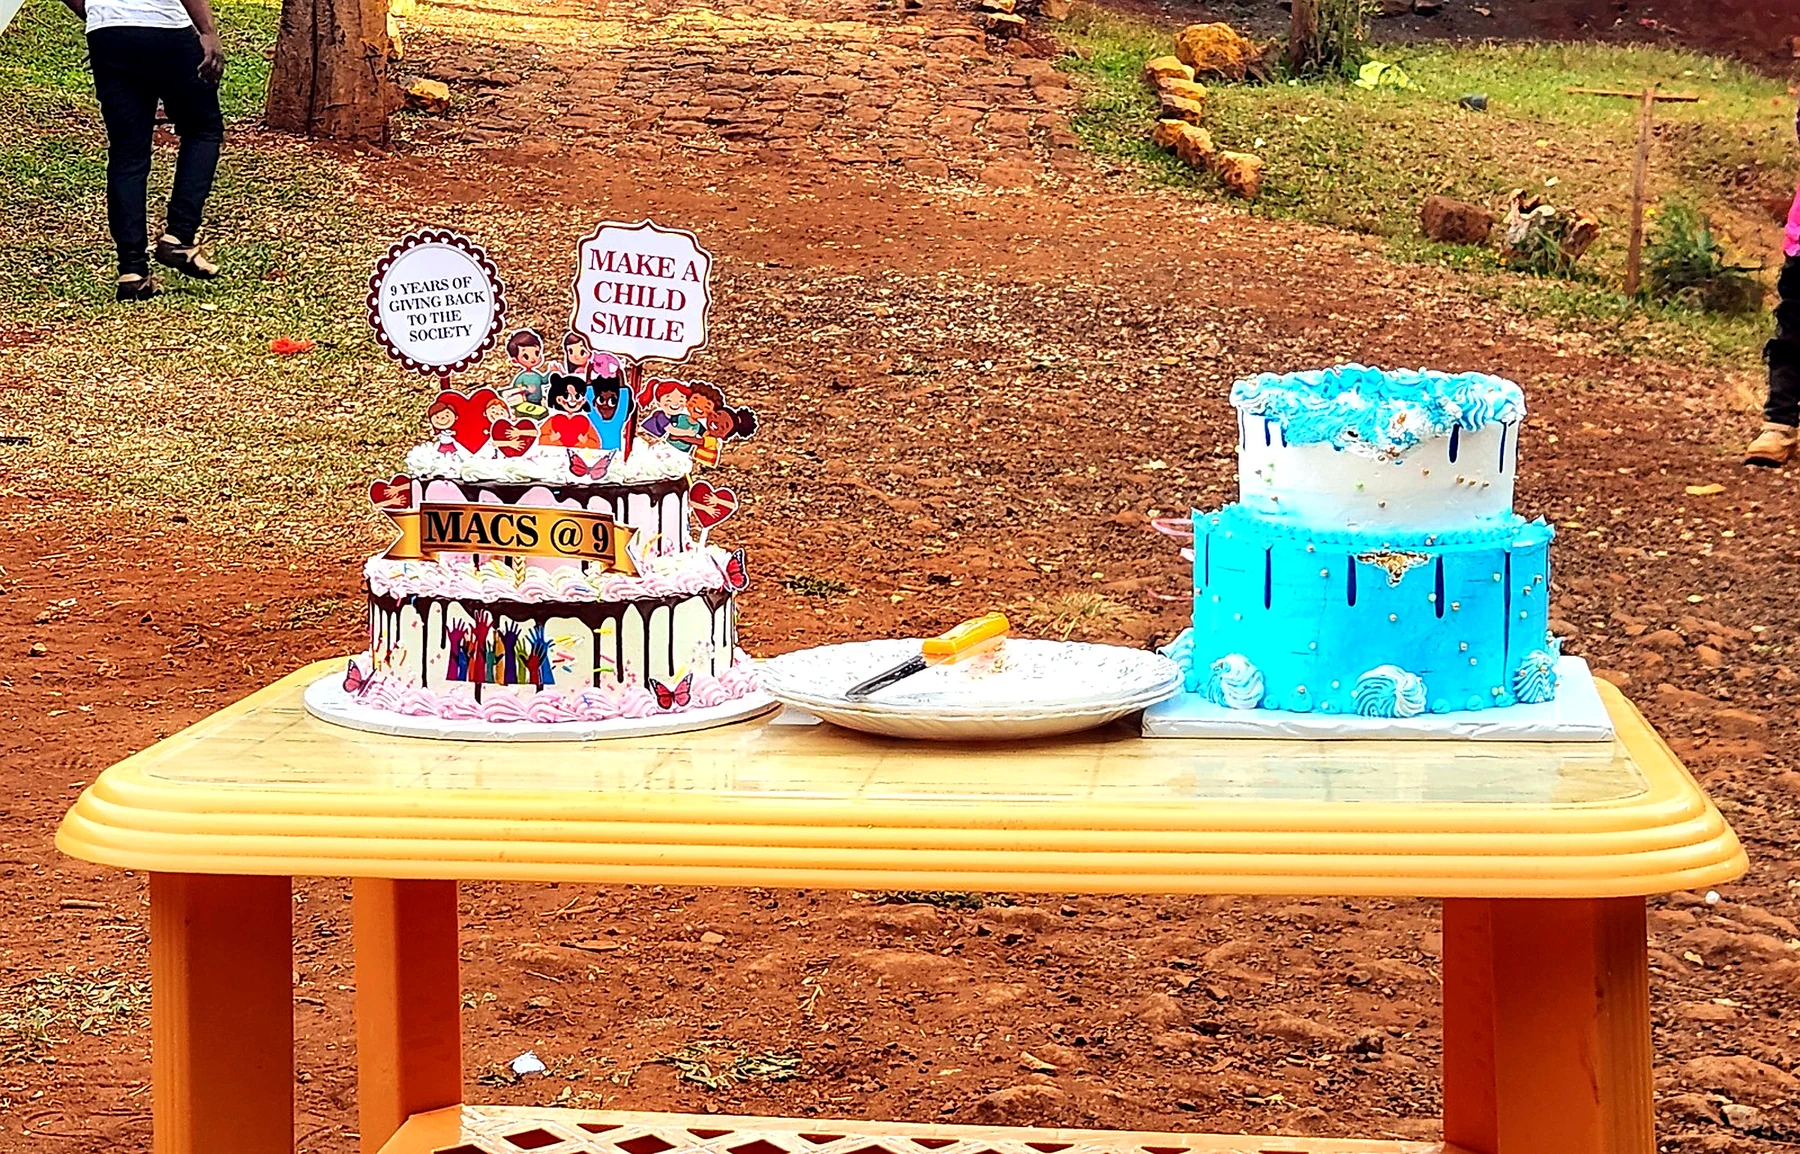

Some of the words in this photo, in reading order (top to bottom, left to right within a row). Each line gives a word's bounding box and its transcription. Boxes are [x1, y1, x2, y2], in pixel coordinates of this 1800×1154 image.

[588, 248, 675, 279] MAKE
[682, 260, 700, 283] A
[390, 285, 397, 297] 9
[399, 278, 449, 295] YEARS
[452, 276, 472, 291] OF
[593, 280, 686, 312] CHILD
[389, 297, 441, 312] GIVING
[445, 291, 485, 307] BACK
[407, 312, 426, 326] TO
[429, 309, 461, 325] THE
[590, 311, 684, 343] SMILE
[409, 325, 472, 343] SOCIETY
[423, 510, 539, 547] MACS
[550, 518, 582, 554] @
[593, 524, 609, 552] 9
